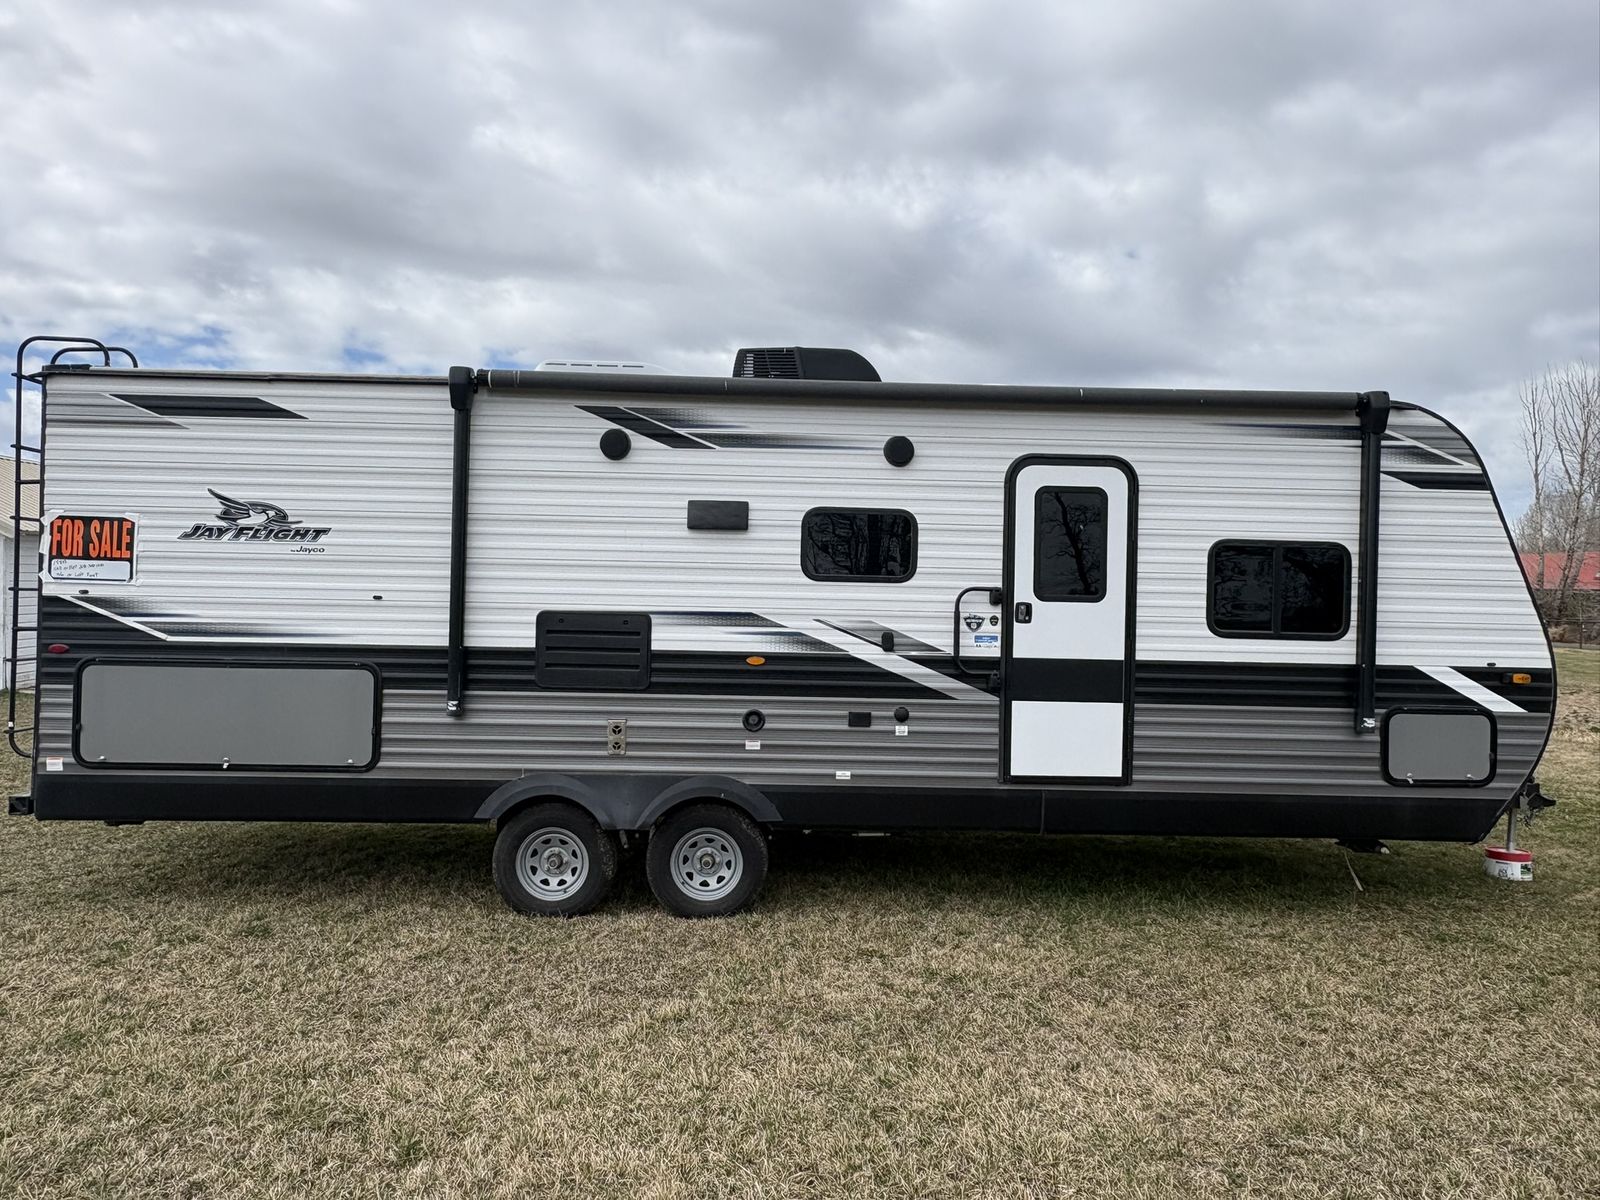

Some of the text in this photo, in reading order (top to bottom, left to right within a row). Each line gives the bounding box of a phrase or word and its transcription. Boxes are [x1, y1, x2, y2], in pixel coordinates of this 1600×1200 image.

[52, 518, 132, 558] FOR SALE
[178, 523, 332, 543] JAY FLIGHT
[296, 546, 325, 554] Jayco
